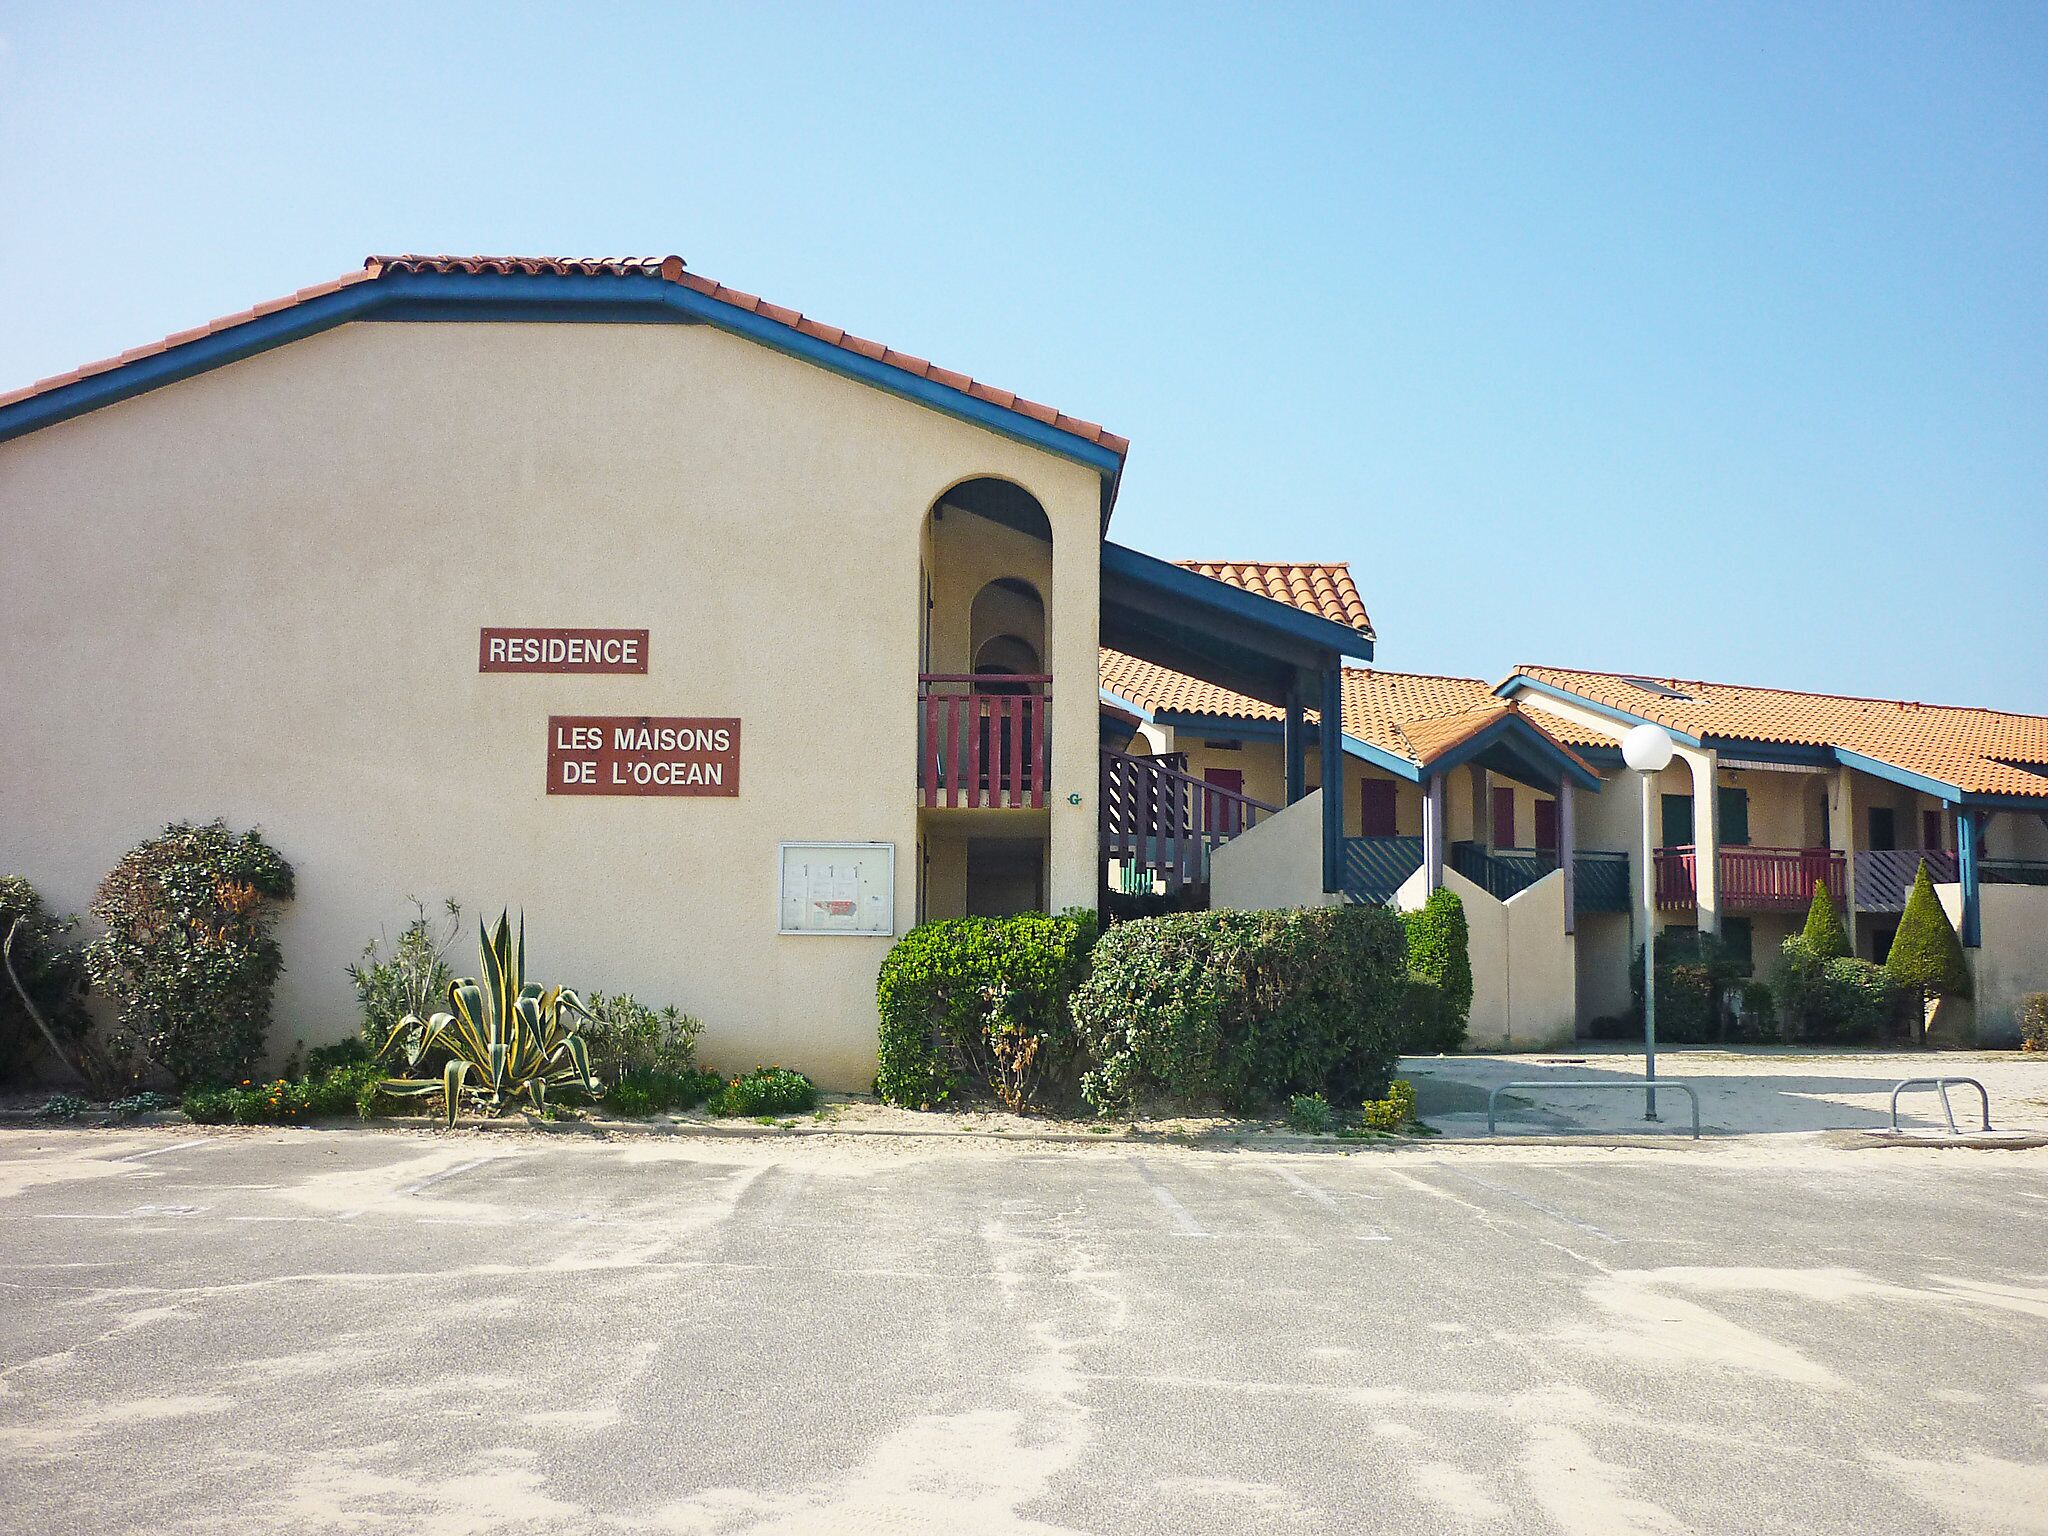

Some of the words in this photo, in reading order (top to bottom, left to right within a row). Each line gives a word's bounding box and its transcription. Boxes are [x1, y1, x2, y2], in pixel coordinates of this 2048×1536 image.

[489, 638, 639, 664] RESIDENCE
[557, 727, 603, 750] LES
[614, 728, 730, 751] MAISONS
[563, 761, 597, 784] DE
[612, 762, 722, 785] L'OCEAN
